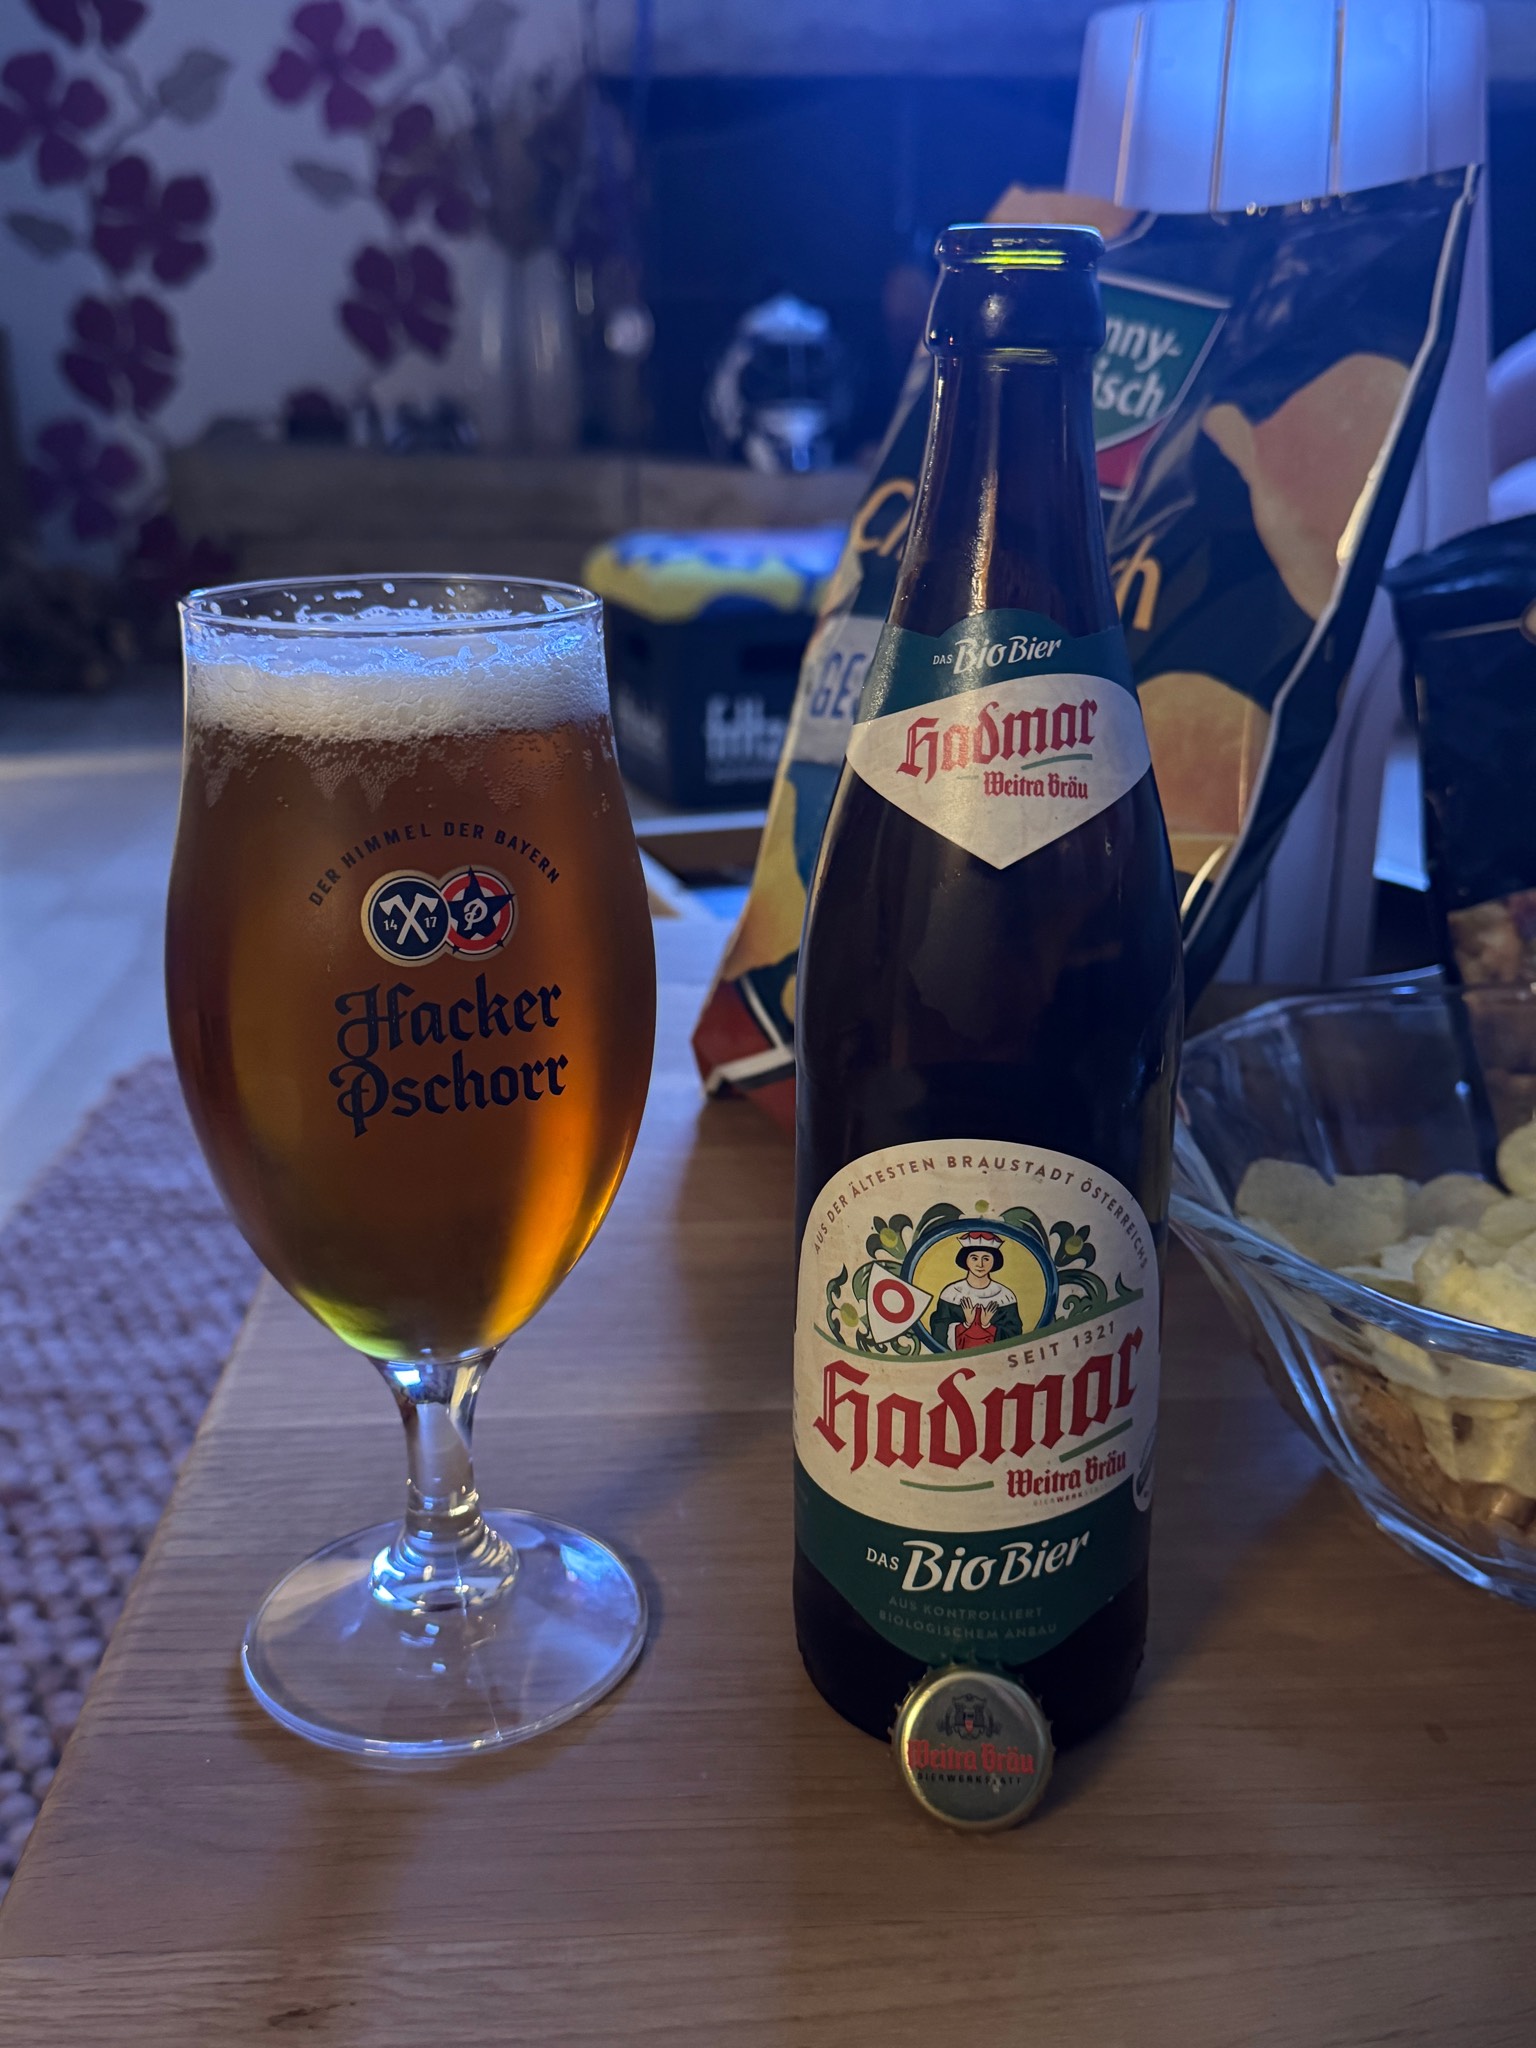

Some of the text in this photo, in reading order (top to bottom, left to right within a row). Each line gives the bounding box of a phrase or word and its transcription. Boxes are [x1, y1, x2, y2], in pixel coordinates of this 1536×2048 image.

[932, 653, 953, 665] DAS
[896, 698, 1098, 784] Hadmar
[983, 769, 1089, 800] Weitra Bräu
[308, 821, 560, 906] DER HIMMEL DER BAYERN
[383, 916, 437, 931] 14 17
[335, 972, 562, 1061] Hacker
[328, 1049, 569, 1138] Pschorr
[814, 1155, 1149, 1270] AUS DER ÄLTESTEN BRAUSTADT ÖSTERREICHS
[1007, 1320, 1114, 1368] SEIT 1321
[813, 1326, 1144, 1473] Hadmar
[1006, 1449, 1127, 1499] Weitra Bräu
[866, 1547, 900, 1571] DAS
[879, 1608, 1057, 1640] BIOLOGISCHEM ANBAU
[888, 1596, 1043, 1621] AUS KONTROLLIERT
[981, 1743, 1035, 1775] Bräu
